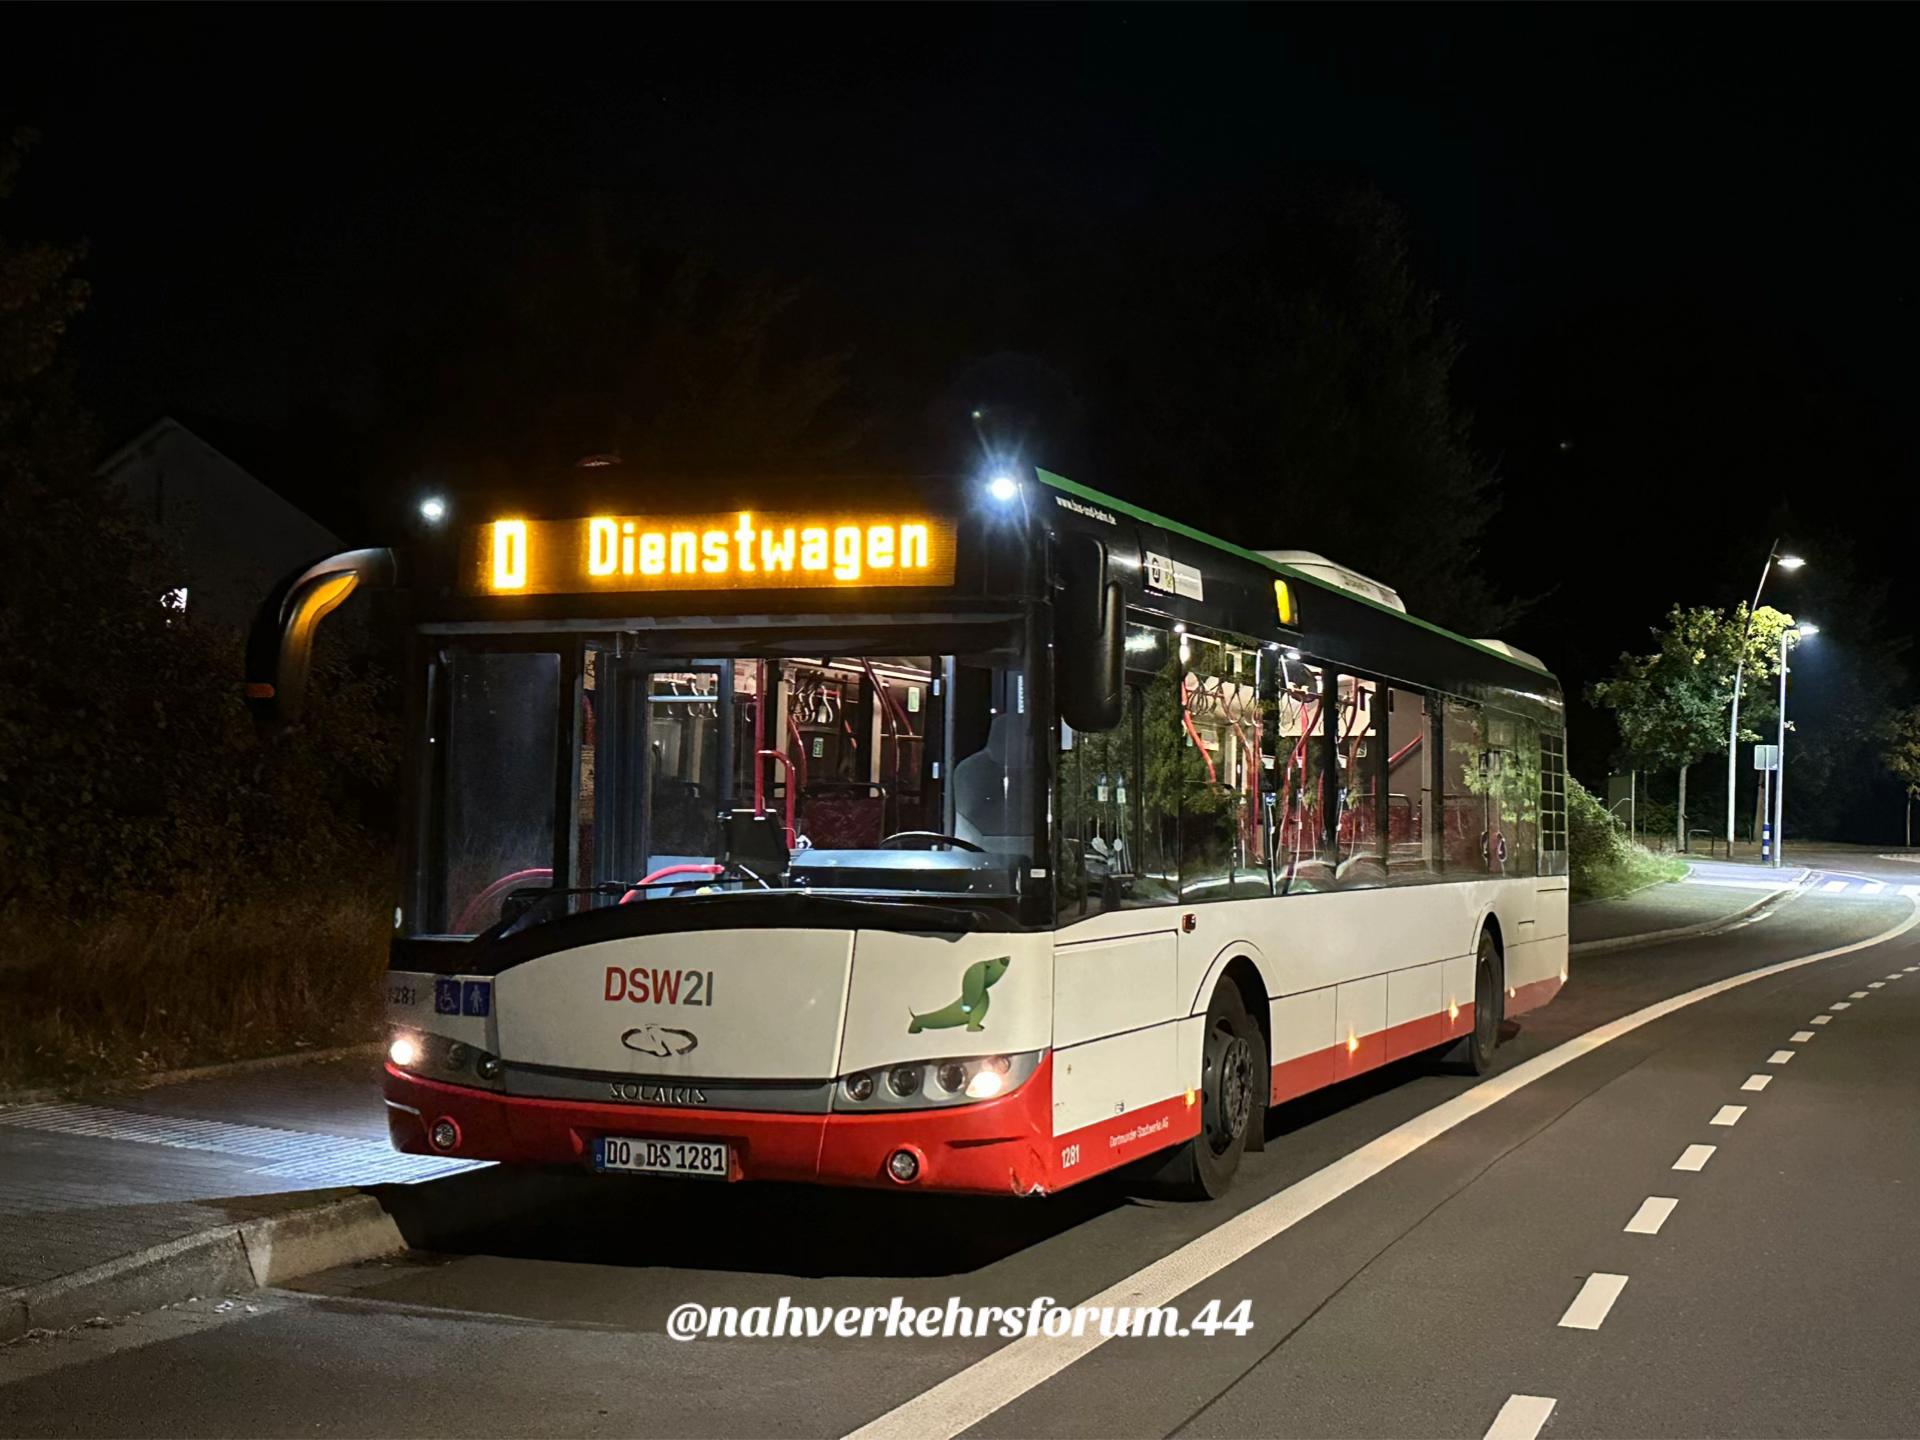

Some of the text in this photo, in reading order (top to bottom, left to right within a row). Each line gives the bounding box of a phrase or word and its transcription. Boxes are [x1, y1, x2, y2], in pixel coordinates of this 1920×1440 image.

[588, 511, 929, 581] Dienstwagen
[608, 1081, 708, 1104] SOLARIS
[606, 1141, 631, 1165] DO
[676, 1145, 725, 1171] 1281
[1061, 1144, 1080, 1168] 1281
